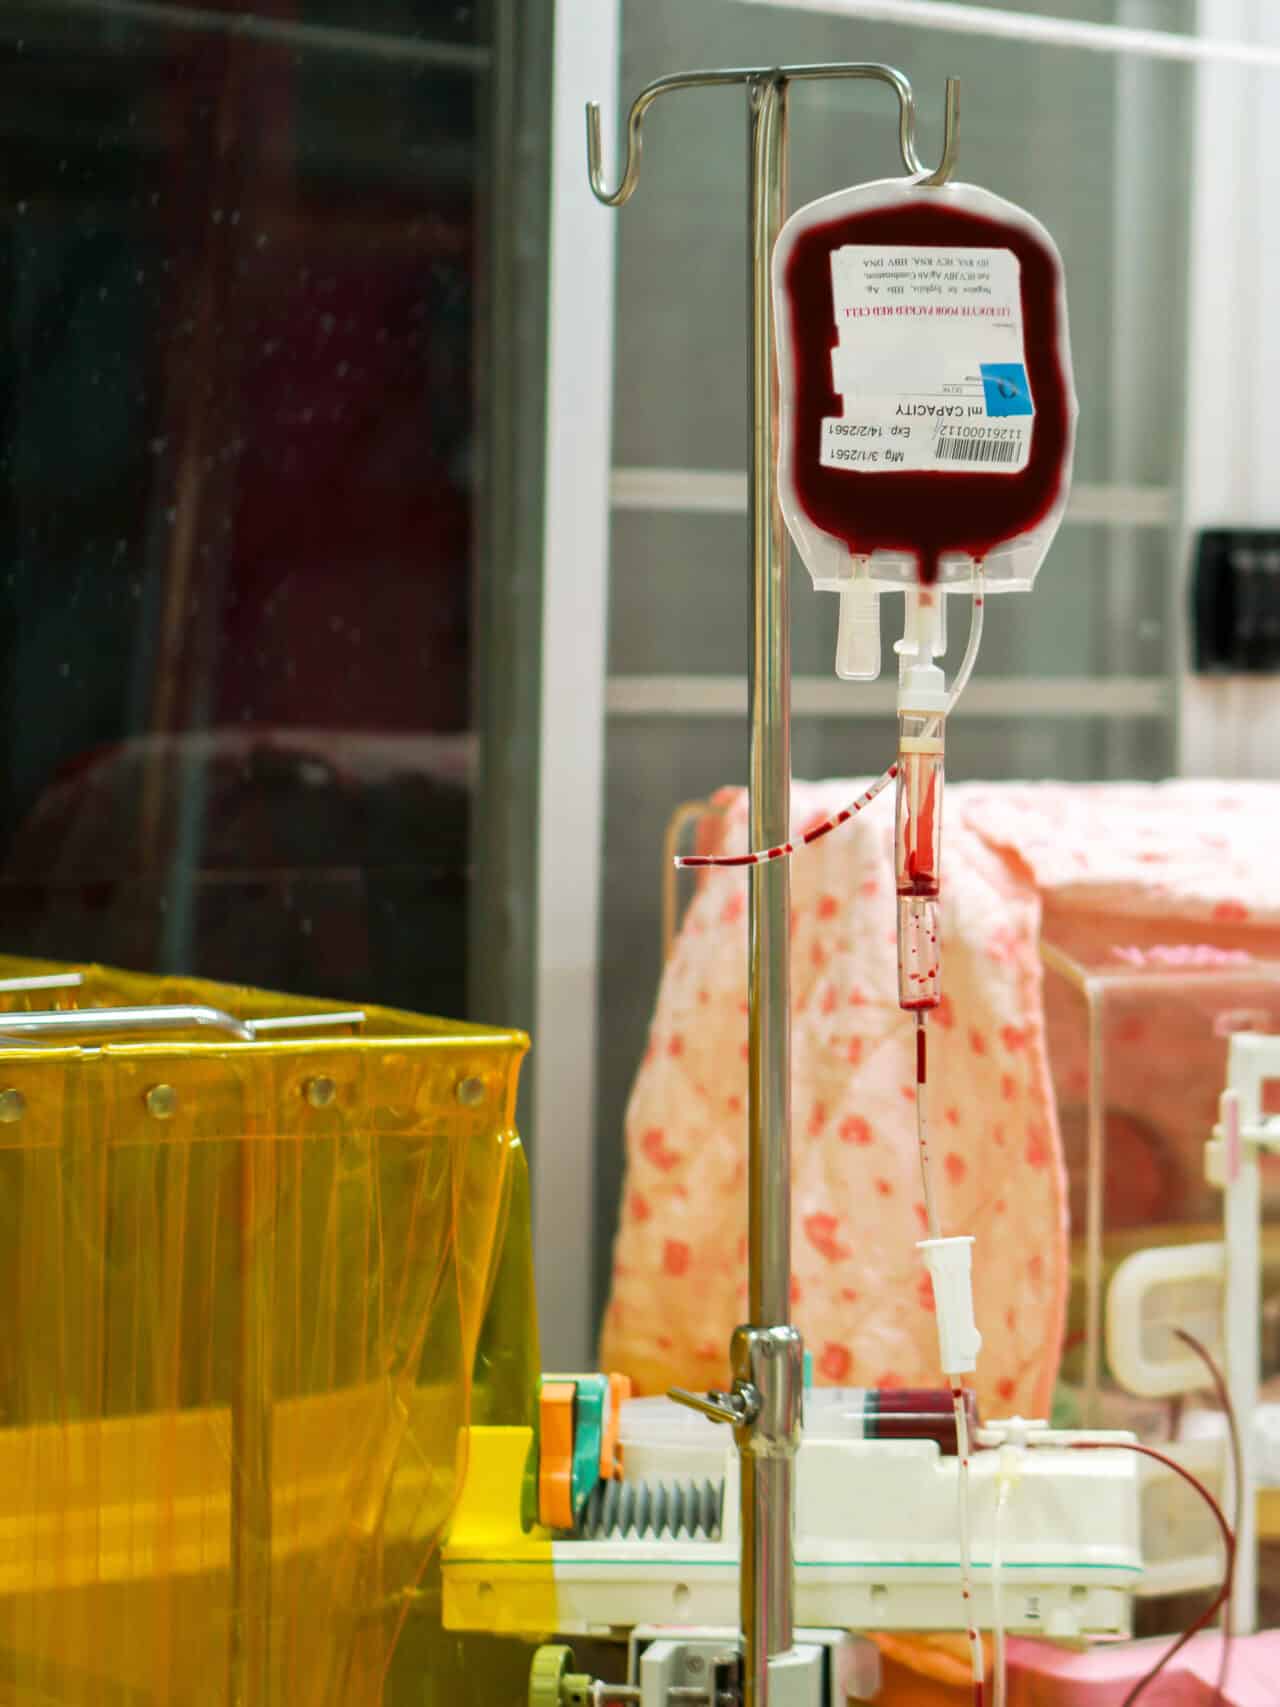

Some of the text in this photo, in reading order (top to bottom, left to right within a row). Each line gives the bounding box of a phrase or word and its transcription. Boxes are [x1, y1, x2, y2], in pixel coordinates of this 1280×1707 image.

[844, 307, 870, 318] CELL
[873, 306, 893, 317] RED
[896, 305, 933, 316] PACKED
[936, 306, 958, 316] POOR
[896, 404, 983, 417] ml CAPACITY
[828, 424, 883, 437] 14/2/2561
[940, 425, 1021, 440] 11261000112
[830, 449, 878, 462] 3/1/2561
